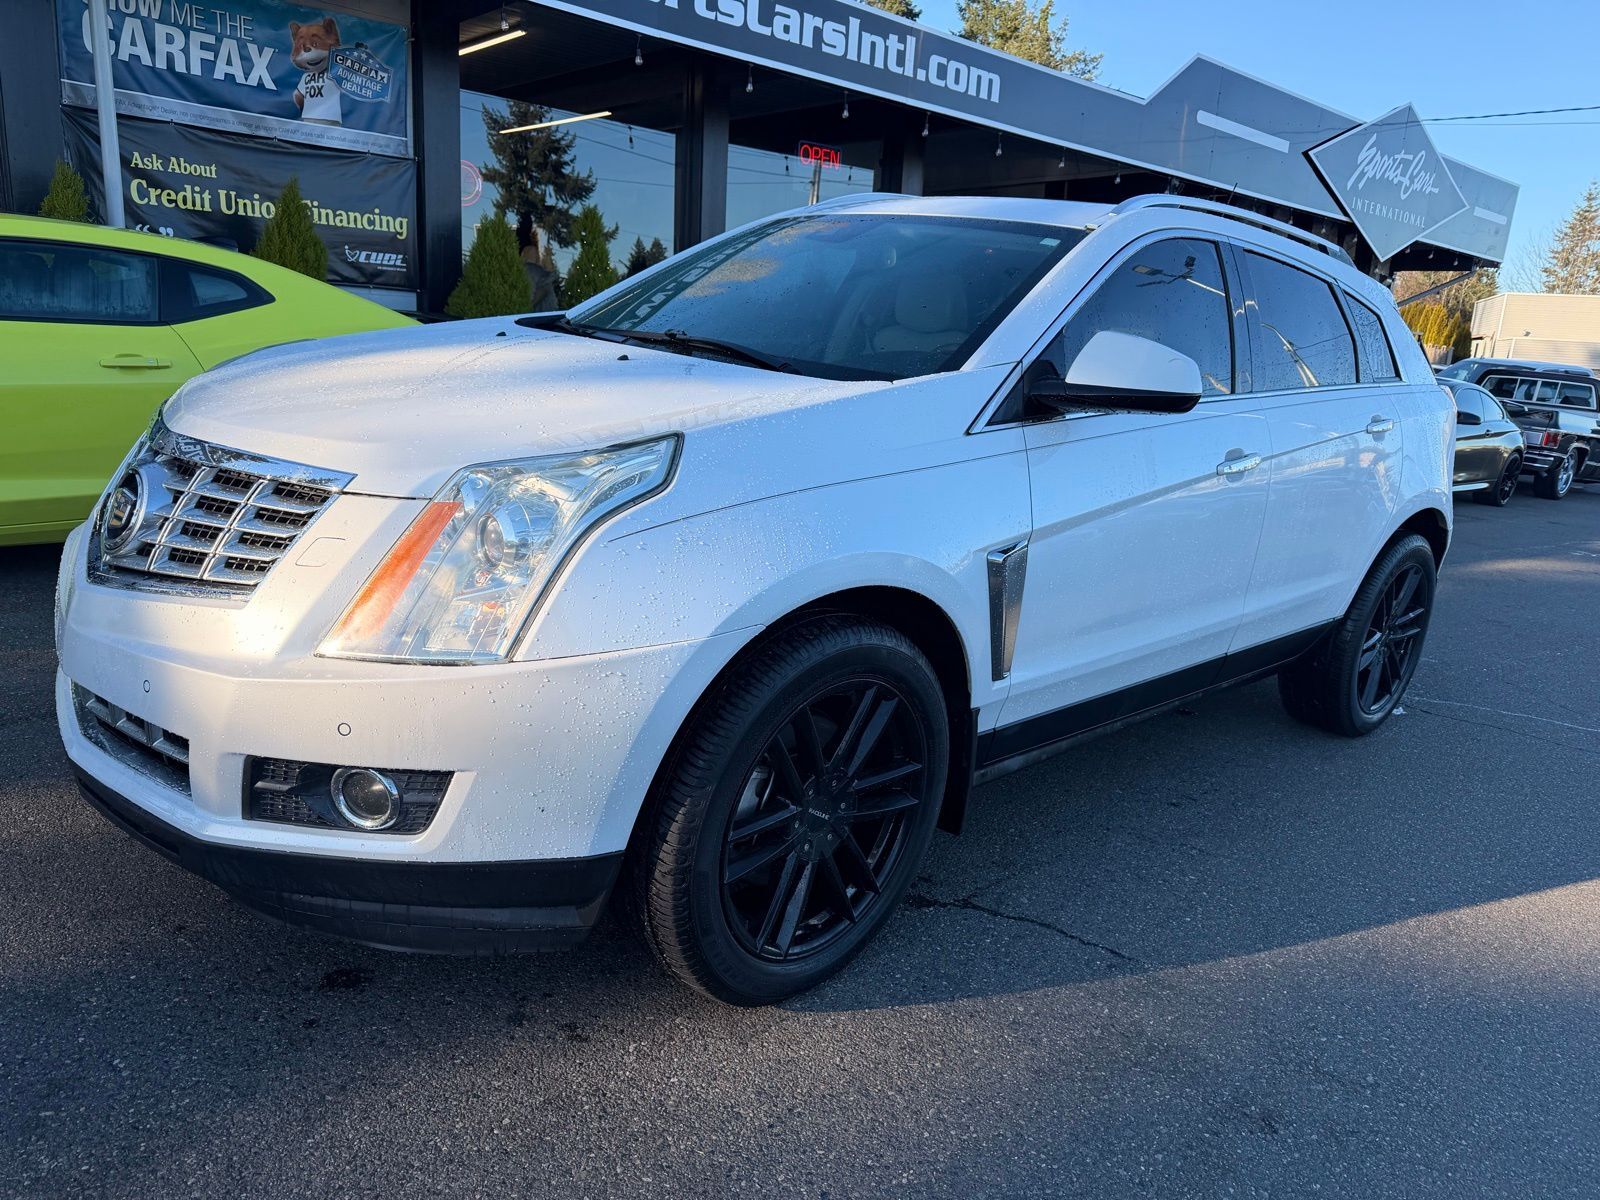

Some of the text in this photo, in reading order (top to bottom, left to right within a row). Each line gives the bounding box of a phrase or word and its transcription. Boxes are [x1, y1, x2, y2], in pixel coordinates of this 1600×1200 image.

[83, 0, 253, 41] OW ME THE
[650, 0, 1001, 103] sCarsIntl.com
[304, 71, 326, 85] CAR
[335, 54, 388, 83] CARFAX
[337, 68, 382, 92] ADVANTAGE
[304, 85, 324, 98] FOX
[341, 80, 373, 98] DEALER
[130, 151, 217, 178] Ask About
[800, 144, 840, 170] OPEN
[1346, 132, 1439, 200] Sports Cars
[130, 178, 212, 212] Credit
[218, 189, 279, 219] Unio
[1352, 196, 1425, 228] INTERNATIONAL
